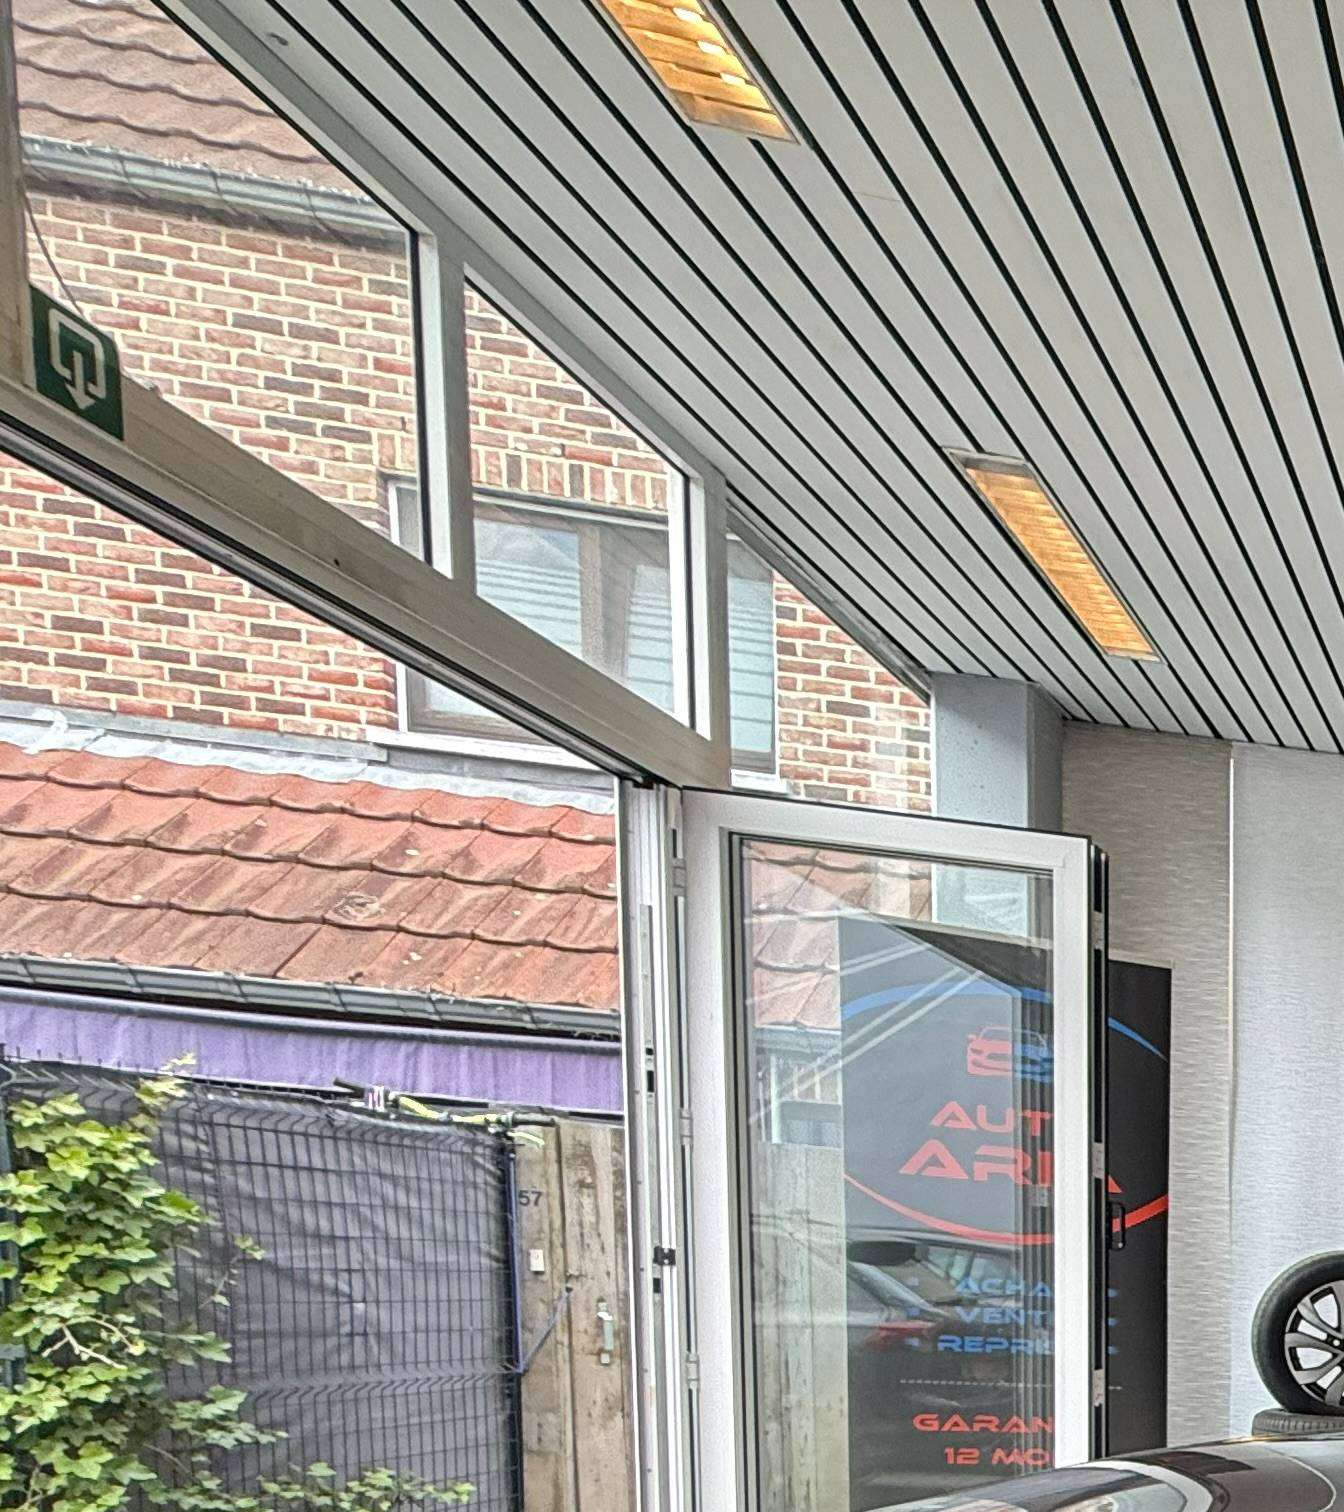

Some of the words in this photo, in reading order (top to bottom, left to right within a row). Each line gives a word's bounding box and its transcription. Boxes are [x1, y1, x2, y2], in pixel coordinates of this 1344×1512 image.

[930, 1101, 1054, 1136] AUT
[518, 1190, 543, 1207] 57
[955, 1276, 1052, 1297] ACHA
[953, 1305, 1053, 1328] VENT
[912, 1413, 1053, 1433] GARAN
[943, 1447, 980, 1464] 12
[991, 1448, 1051, 1466] MO
